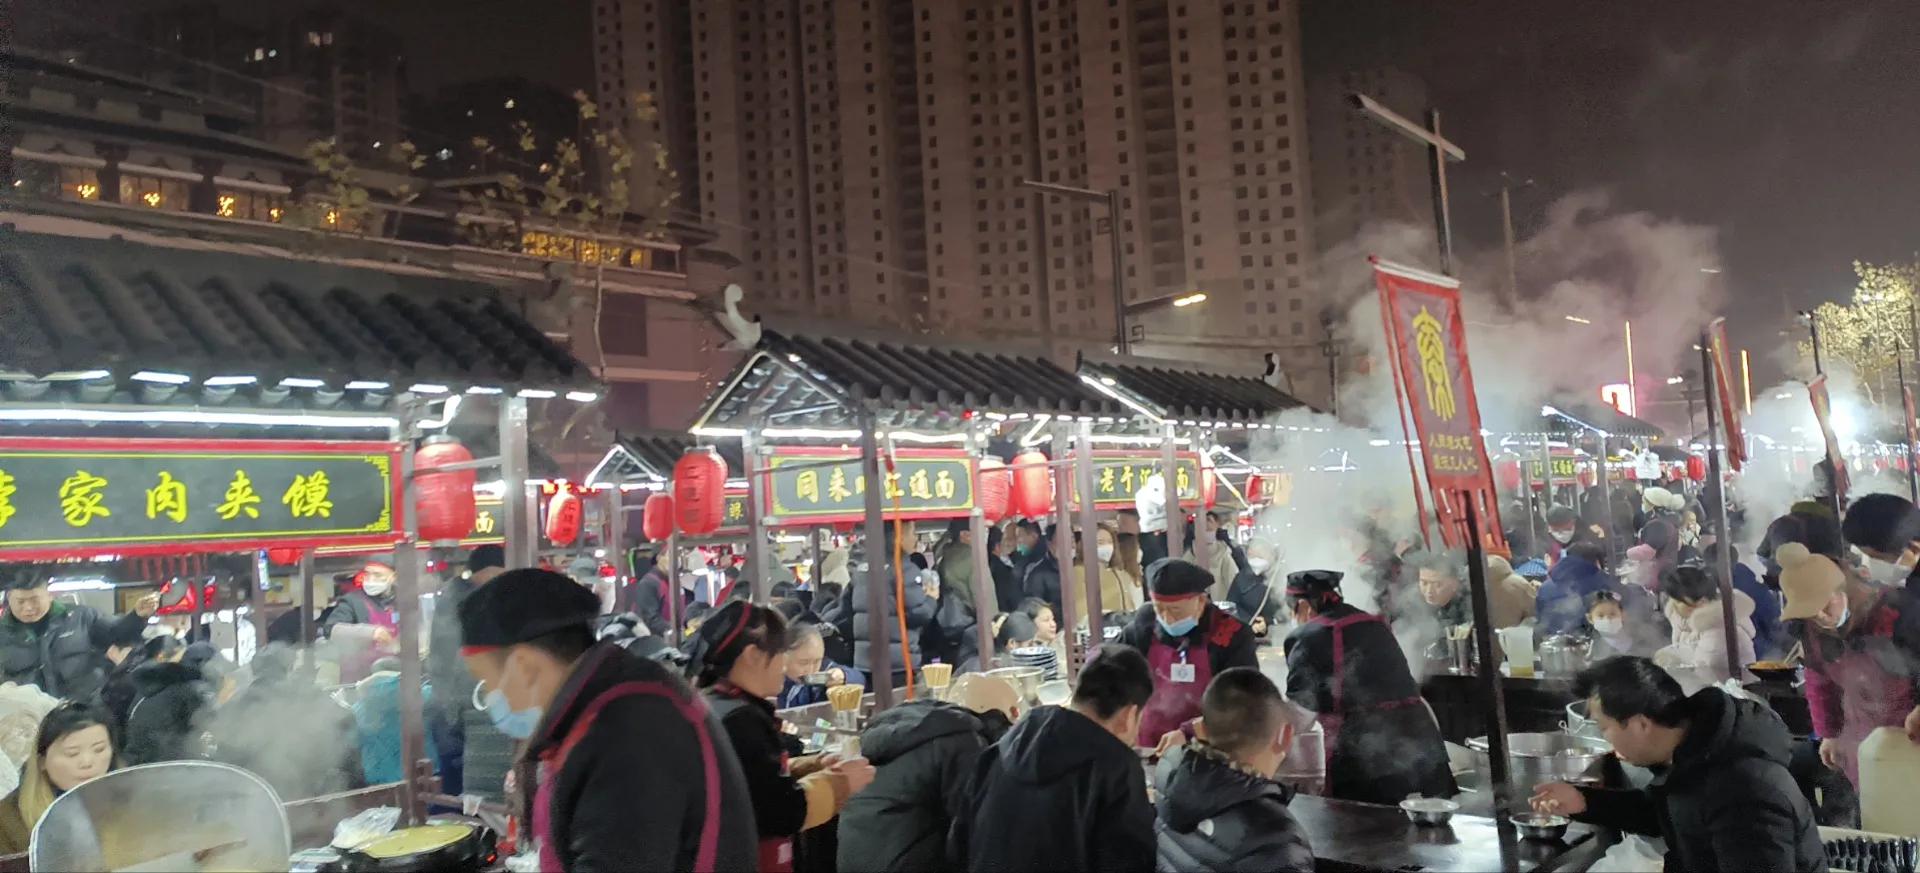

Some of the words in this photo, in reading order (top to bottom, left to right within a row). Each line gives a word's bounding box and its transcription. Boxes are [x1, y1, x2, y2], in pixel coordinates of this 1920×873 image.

[796, 464, 955, 502] 同来汇通面
